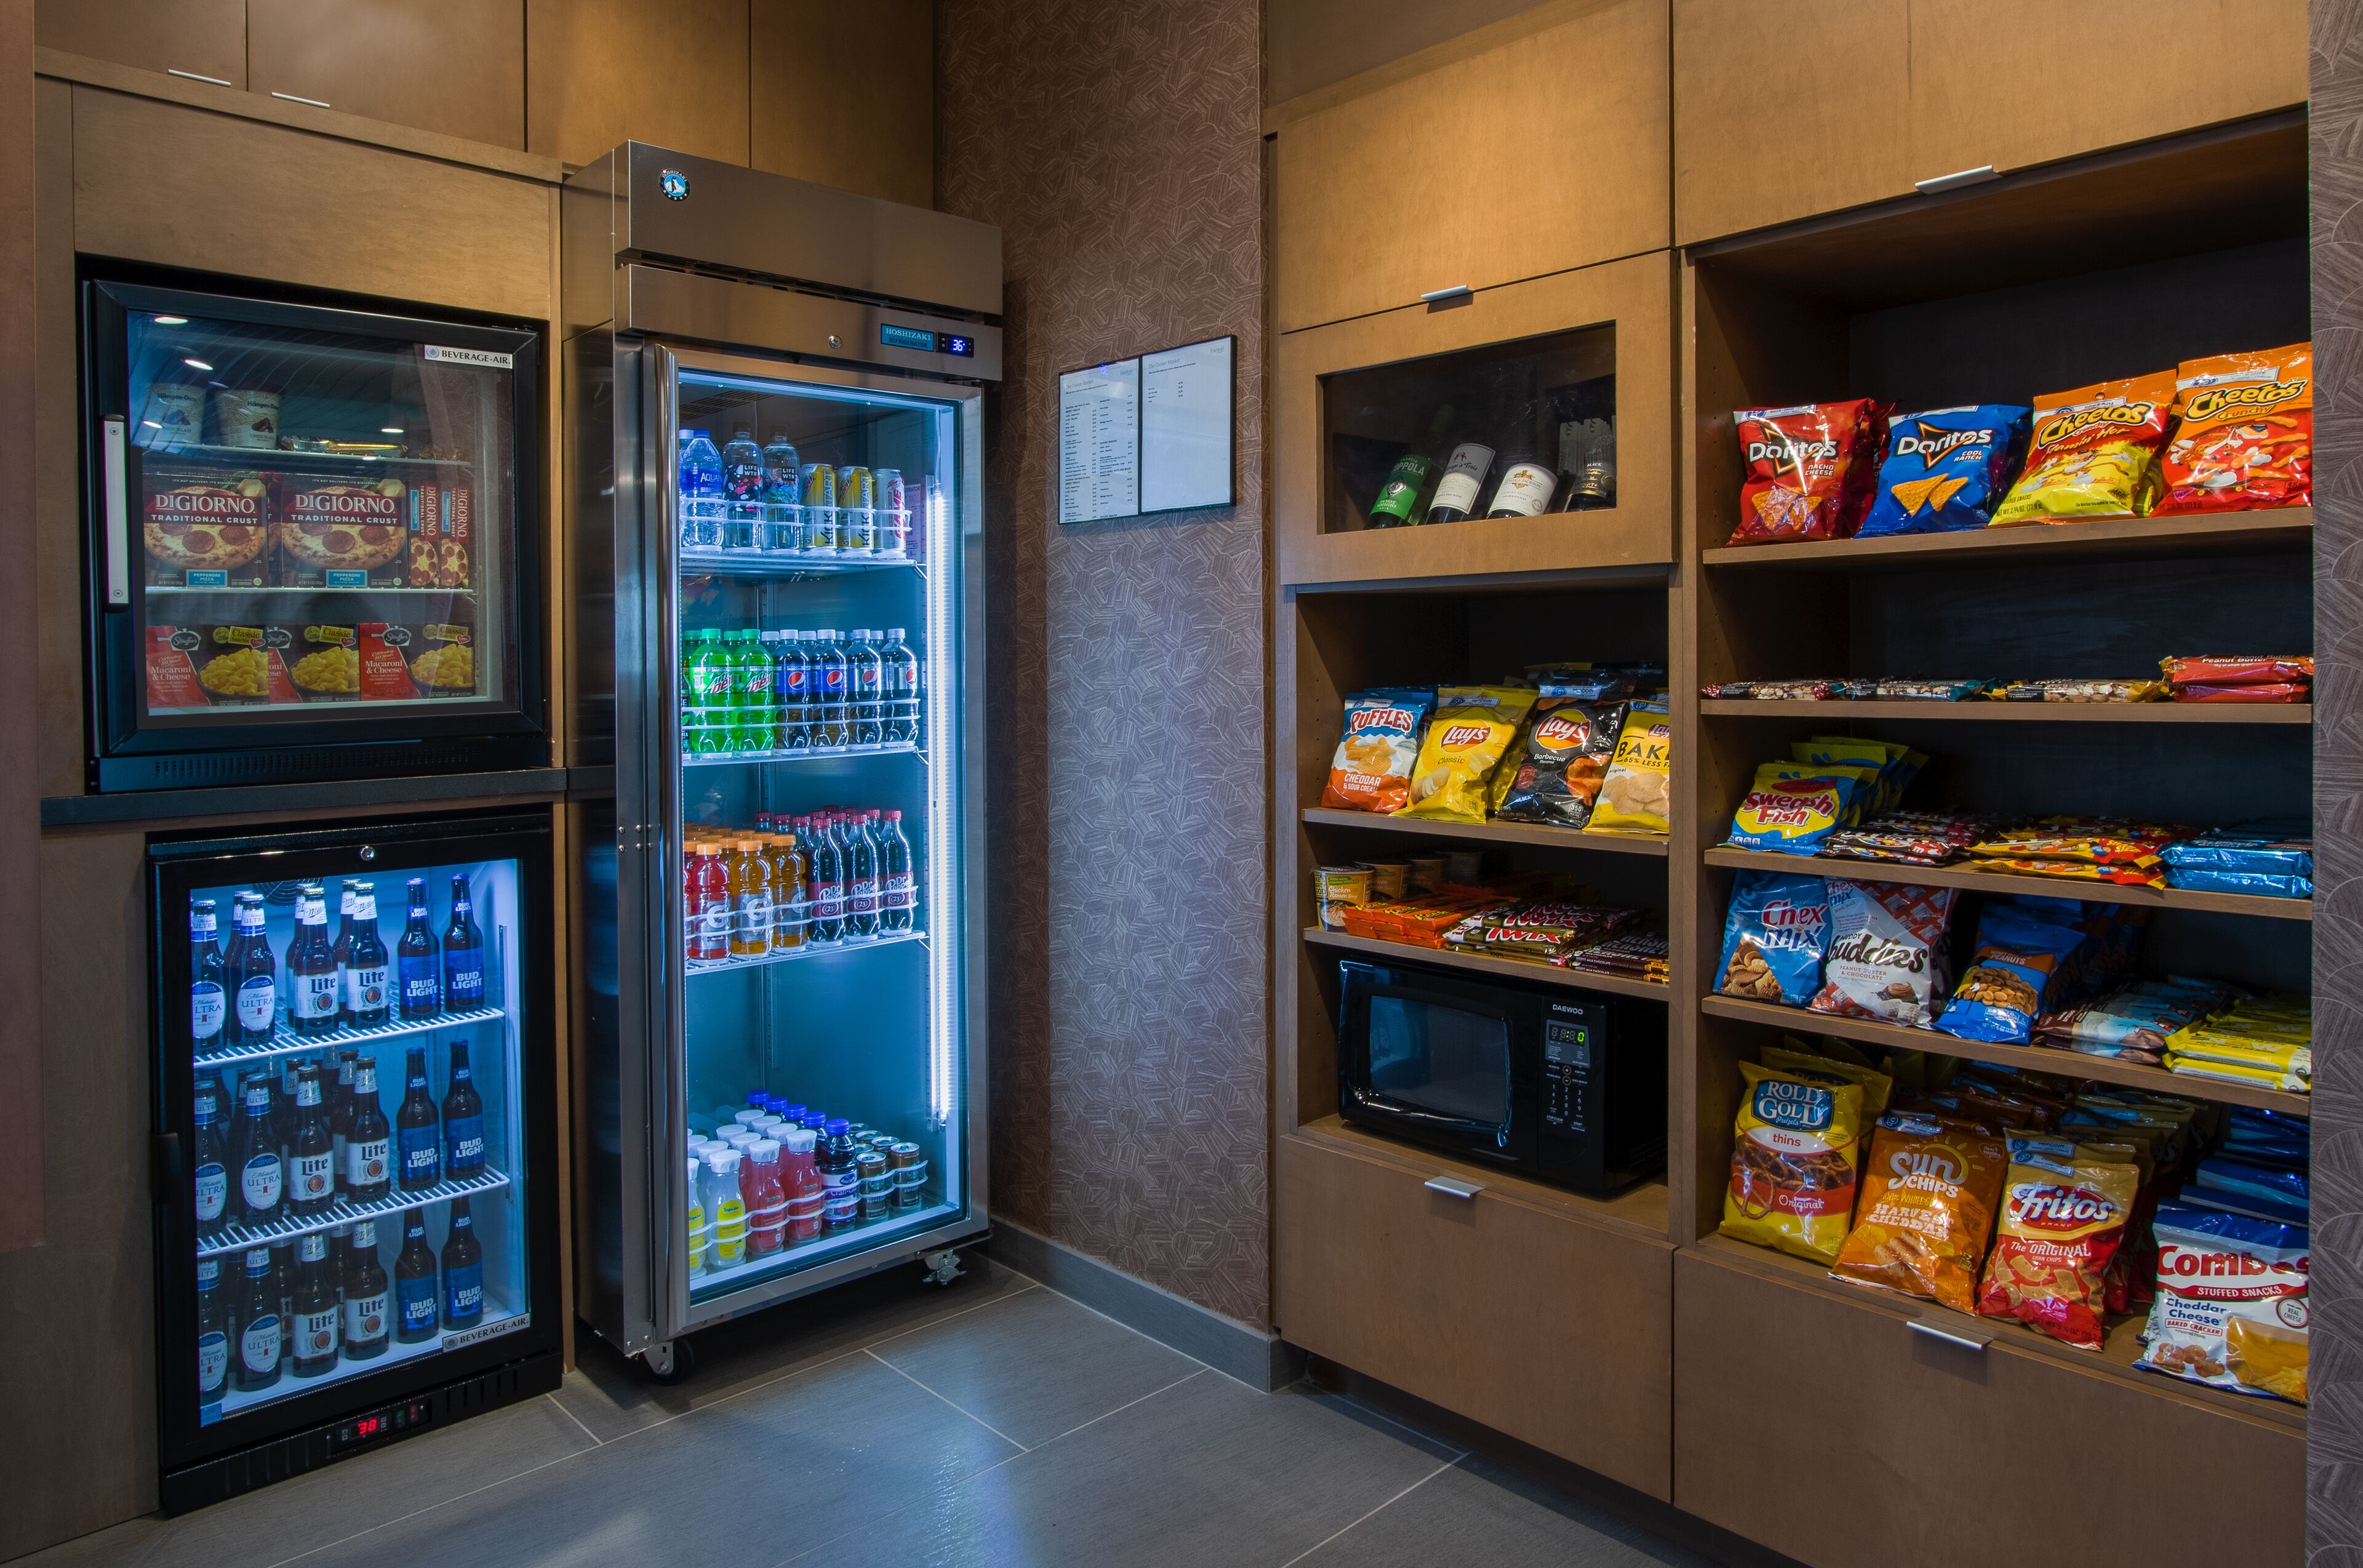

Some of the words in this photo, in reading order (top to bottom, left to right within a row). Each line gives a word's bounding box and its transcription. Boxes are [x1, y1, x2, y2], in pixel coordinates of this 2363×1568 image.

[886, 328, 930, 341] HOSHIZAKI
[889, 338, 927, 349] REFRIGERATOR
[2186, 382, 2305, 420] Cheetos
[2215, 404, 2275, 421] Crunchy
[2039, 403, 2151, 444] Cheetos
[2072, 422, 2109, 436] Crunchy
[2097, 427, 2131, 439] Hot
[1897, 430, 1993, 456] Doritos
[1749, 441, 1837, 462] Doritos
[156, 494, 255, 513] DIGIORNO
[295, 495, 395, 513] DIGIORNO
[151, 514, 222, 523] TRADITIONAL
[291, 514, 362, 523] TRADITIONAL
[426, 487, 436, 536] DIGIORNO
[458, 489, 467, 537] DIGIORNO
[232, 629, 260, 638] Classic
[323, 628, 350, 638] Classic
[440, 626, 466, 635] Classic
[1351, 708, 1413, 734] RUFFLES
[1538, 716, 1588, 740] Lay's
[1442, 725, 1491, 746] Lay's
[1438, 756, 1465, 764] Classic
[1534, 753, 1565, 762] Barbecue
[1344, 773, 1381, 786] CHEDDAR
[1348, 783, 1360, 791] SOUR
[1361, 785, 1378, 793] CREAM
[1570, 804, 1582, 812] 350
[1757, 806, 1810, 826] Fish
[862, 881, 873, 889] Dr
[896, 876, 906, 884] Dr
[828, 885, 841, 893] Dr
[1827, 881, 1854, 896] Chex
[1830, 888, 1853, 906] mix
[1762, 897, 1828, 926] Chex
[1764, 925, 1826, 951] mix
[1828, 934, 1928, 973] buddies
[1990, 954, 2026, 965] PEANUTS
[359, 970, 385, 986] Lite
[456, 971, 479, 982] BUD
[1847, 972, 1884, 980] CHOCOLATE
[310, 977, 335, 993] Lite
[410, 978, 434, 989] BUD
[452, 977, 482, 990] LIGHT
[407, 986, 438, 997] LIGHT
[241, 997, 273, 1008] ULTRA
[1553, 1004, 1583, 1015] DAEWOO
[1767, 1081, 1821, 1103] ROLD
[1758, 1097, 1825, 1126] GOLD
[1776, 1117, 1799, 1126] Pretzels
[1911, 1120, 1936, 1128] PEPCOIN
[460, 1138, 481, 1150] BUD
[1772, 1132, 1801, 1147] thins
[361, 1143, 386, 1161] Lite
[412, 1148, 435, 1159] BUD
[455, 1145, 484, 1158] LIGHT
[1983, 1150, 2001, 1158] Healthy
[302, 1158, 328, 1175] Lite
[407, 1154, 438, 1168] LIGHT
[1888, 1151, 1967, 1190] Sun
[247, 1174, 280, 1186] ULTRA
[1906, 1177, 1959, 1198] CHIPS
[1779, 1194, 1825, 1209] Original
[2011, 1183, 2114, 1222] Fritos
[1875, 1203, 1954, 1228] HARVEST
[1868, 1214, 1949, 1241] CHEDDAR
[2010, 1241, 2026, 1251] The
[2031, 1243, 2092, 1257] ORIGINAL
[458, 1286, 481, 1298] BUD
[2197, 1287, 2239, 1297] STUFFED
[2242, 1286, 2282, 1297] SNACKS
[359, 1297, 384, 1316] Lite
[410, 1297, 433, 1311] BUD
[455, 1292, 482, 1307] LIGHT
[2166, 1298, 2226, 1314] Cheddar
[406, 1305, 437, 1319] LIGHT
[2284, 1312, 2302, 1323] CHEESE
[2288, 1308, 2300, 1316] REAL
[308, 1313, 334, 1332] Lite
[2190, 1323, 2220, 1335] CRACKER
[247, 1336, 280, 1350] ULTRA
[358, 1418, 378, 1434] 38
